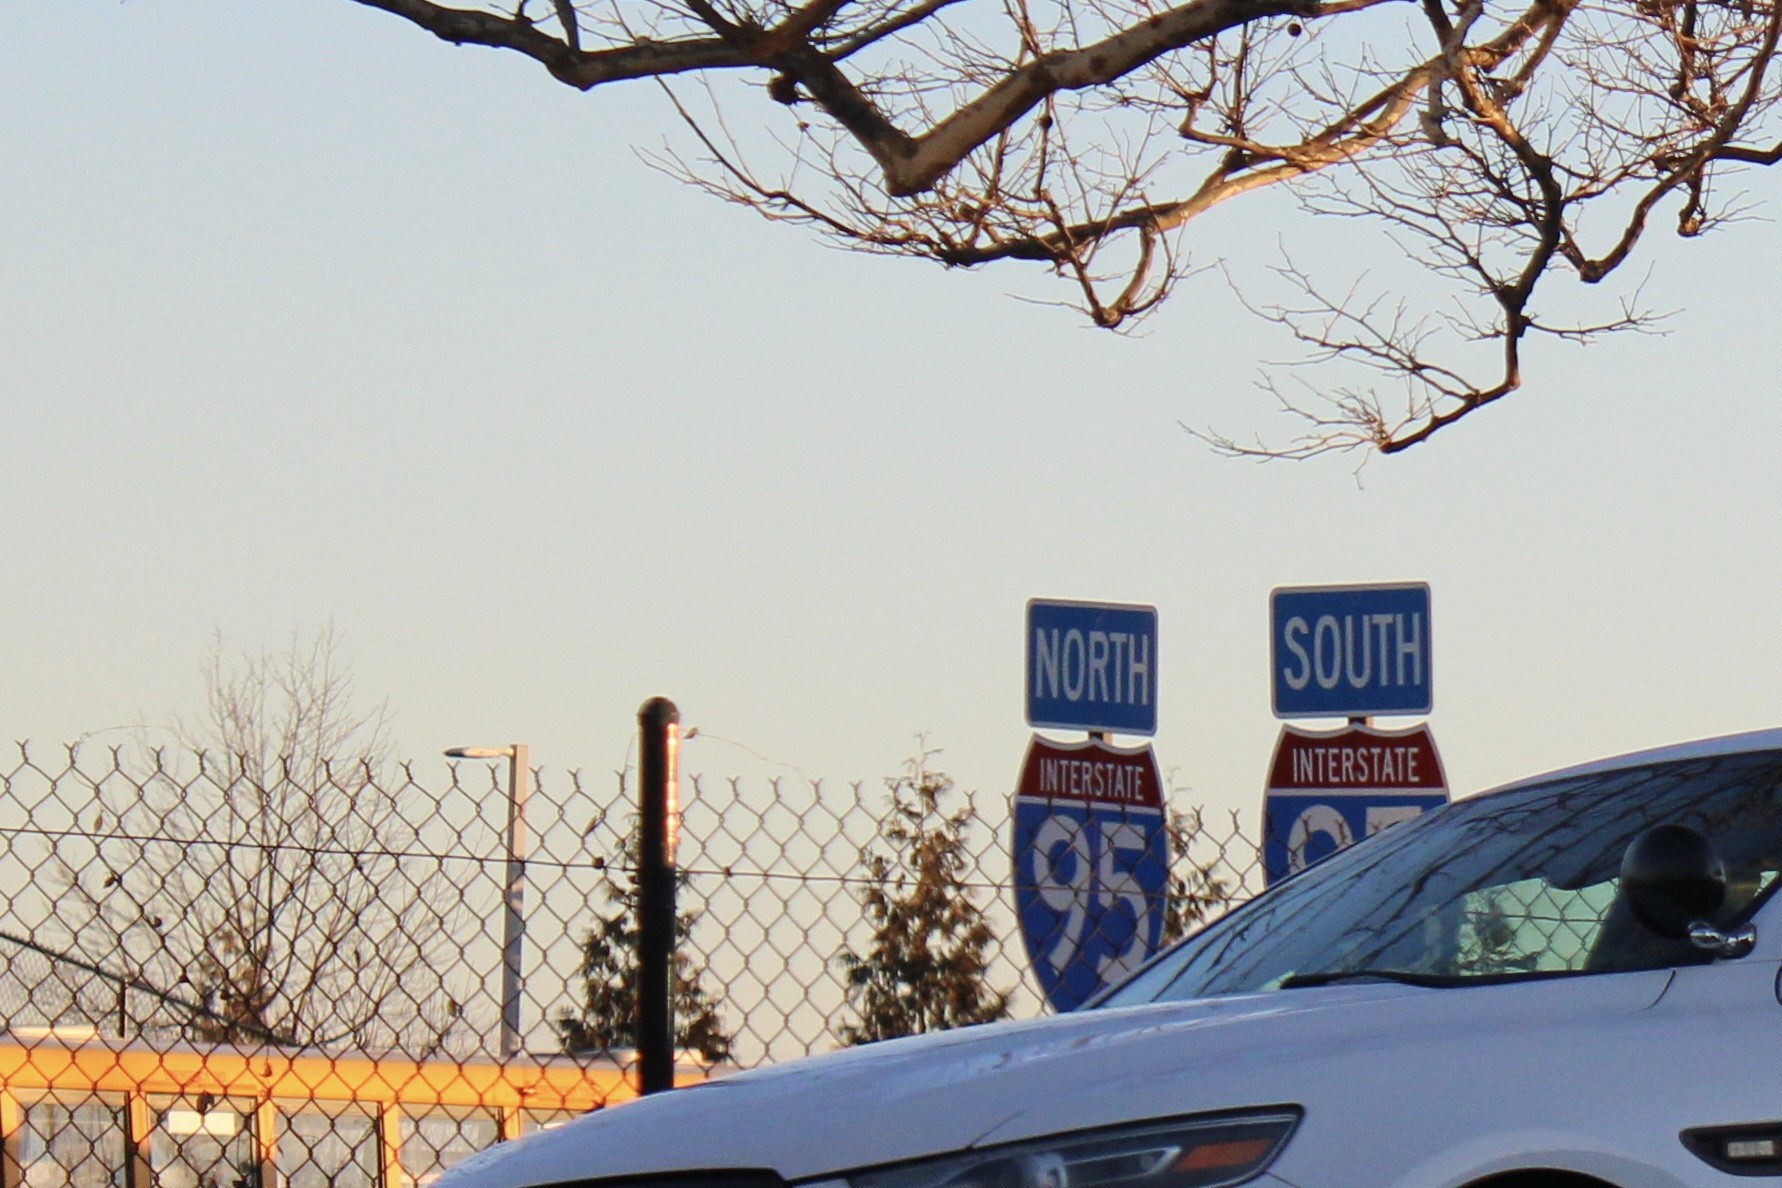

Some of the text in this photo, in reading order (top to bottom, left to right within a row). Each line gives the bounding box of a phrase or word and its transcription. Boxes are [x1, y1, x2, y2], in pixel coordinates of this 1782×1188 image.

[1036, 627, 1149, 706] NORTH
[1284, 613, 1422, 690] SOUTH
[1039, 757, 1145, 801] INTERSTATE
[1292, 746, 1421, 784] INTERSTATE
[1033, 814, 1150, 985] 95
